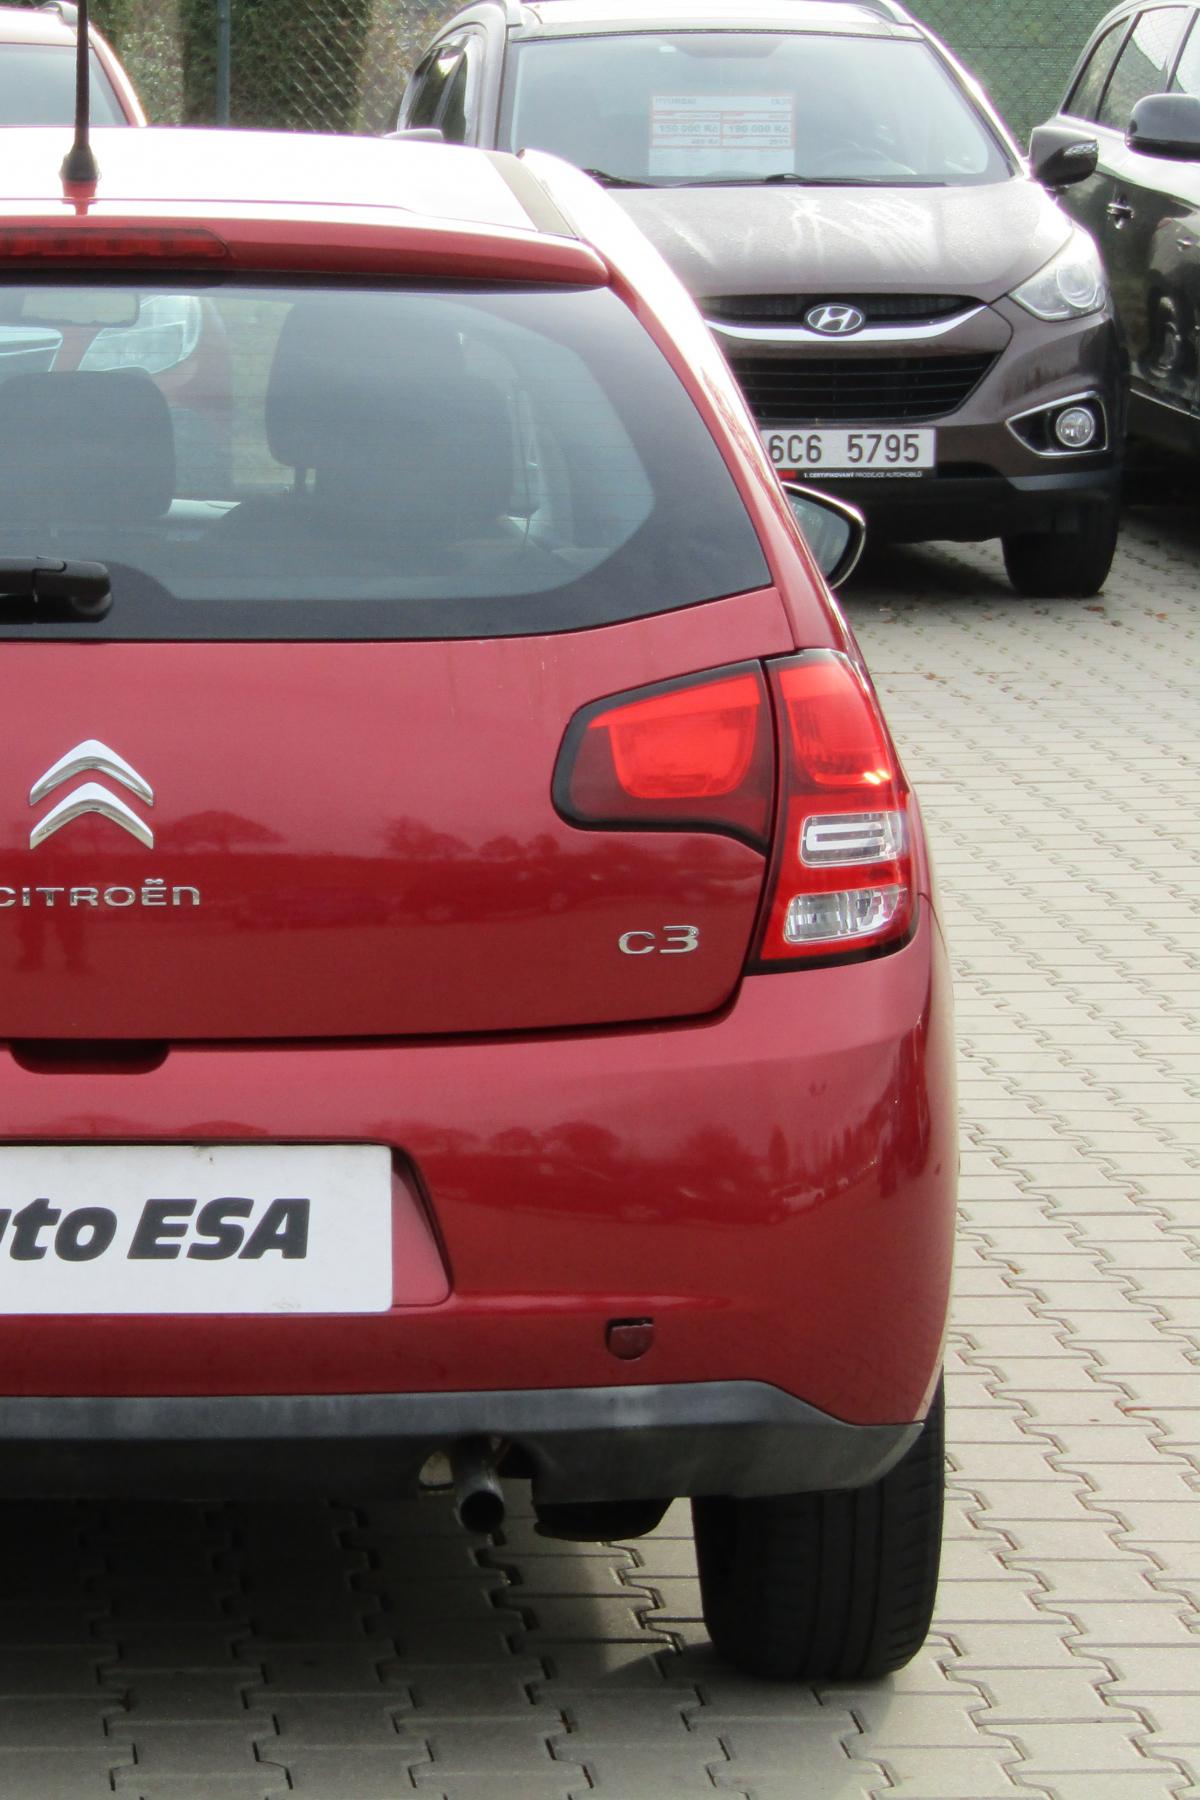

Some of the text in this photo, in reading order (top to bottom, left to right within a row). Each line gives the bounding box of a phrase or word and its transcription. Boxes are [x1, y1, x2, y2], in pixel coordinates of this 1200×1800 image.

[768, 433, 920, 464] 6C6 5795
[618, 925, 699, 954] C3
[126, 1197, 311, 1261] ESA
